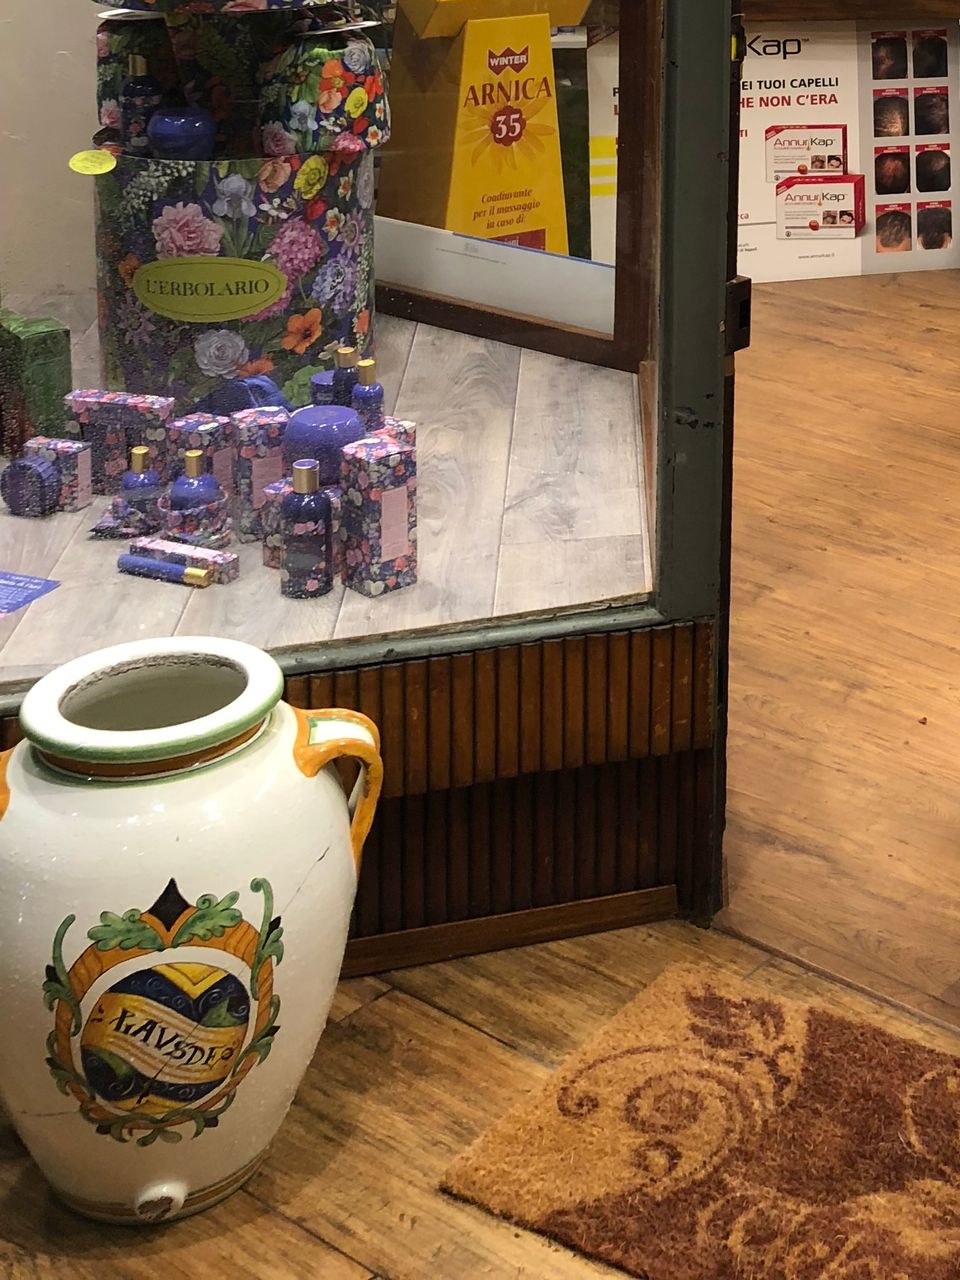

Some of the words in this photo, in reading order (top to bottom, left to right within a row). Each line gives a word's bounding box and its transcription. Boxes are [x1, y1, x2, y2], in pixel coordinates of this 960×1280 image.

[490, 53, 527, 66] WINTER
[757, 80, 786, 89] TUOI
[790, 77, 839, 88] CAPELLI
[464, 76, 552, 107] ARNICA
[759, 95, 791, 107] NON
[796, 94, 839, 105] C'ERA
[495, 113, 522, 138] 35
[481, 188, 533, 203] Coadiuvante
[473, 210, 486, 221] per
[489, 206, 495, 216] il
[497, 199, 540, 214] massaggio
[487, 220, 494, 229] in
[497, 218, 514, 228] caso
[516, 214, 524, 224] di
[146, 279, 270, 297] L'ERBOLARIO
